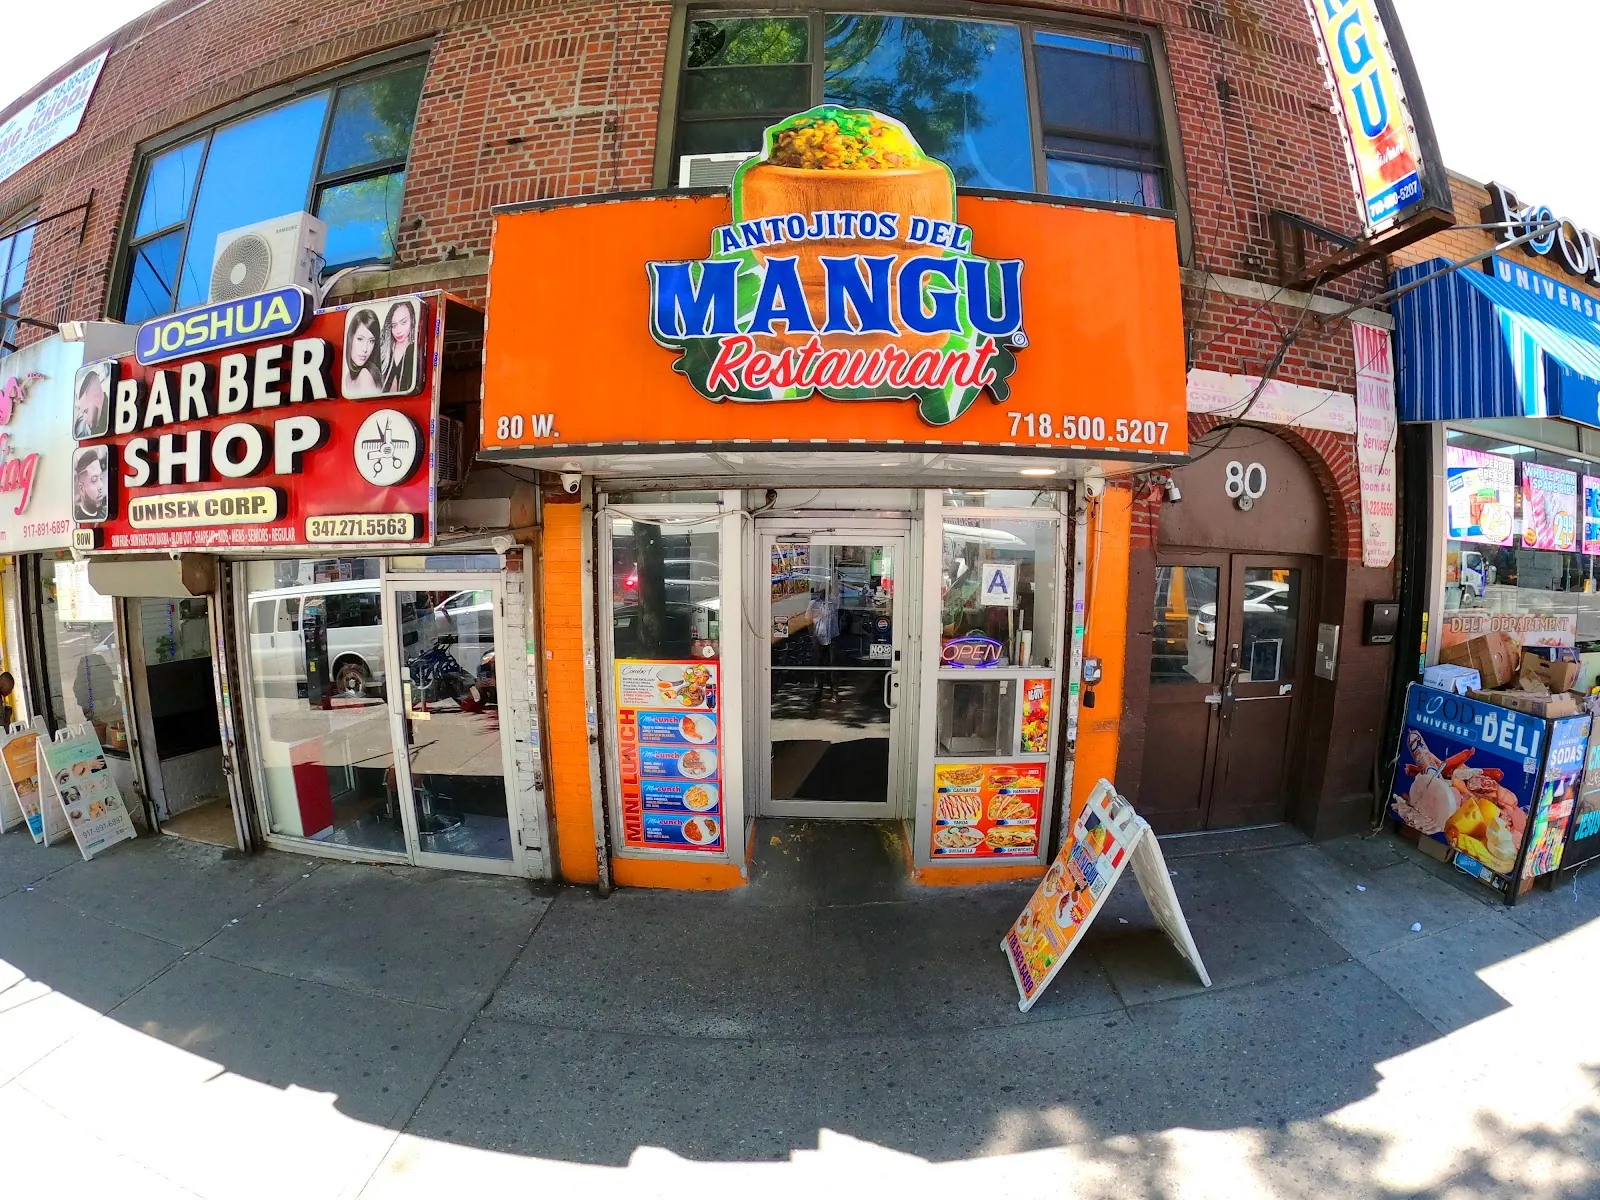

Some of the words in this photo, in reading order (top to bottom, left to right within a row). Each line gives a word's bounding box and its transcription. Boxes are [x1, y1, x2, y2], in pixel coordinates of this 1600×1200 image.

[24, 79, 92, 138] SCHOOL
[721, 212, 898, 253] ANTOJITOS
[909, 217, 970, 252] DEL
[651, 255, 1023, 337] MANGU
[143, 295, 292, 357] JOSHUA
[1353, 322, 1391, 375] VMR
[707, 335, 998, 392] Restaurant
[114, 337, 329, 436] BARBER
[1357, 382, 1374, 408] TAX
[496, 414, 523, 440] 80
[531, 413, 560, 438] W.
[1007, 411, 1169, 445] 718.500.5207
[124, 414, 321, 489] SHOP
[1224, 460, 1267, 499] 80
[1360, 462, 1373, 475] 2nd
[1524, 464, 1553, 481] WHOLE
[1555, 470, 1575, 485] PORK
[132, 499, 200, 523] UNISEX
[204, 495, 268, 517] CORP.
[23, 519, 70, 539] 917-891-6897
[75, 532, 91, 546] 80W
[247, 528, 269, 541] SENIORS
[271, 527, 296, 542] REGULAR
[311, 517, 407, 538] 347.271.5563
[986, 569, 1008, 595] A
[1451, 617, 1483, 633] DELI
[1491, 616, 1569, 633] DEPARTMENT
[871, 645, 883, 654] NO
[942, 644, 1003, 661] OPEN
[1417, 690, 1476, 725] FOOD
[1416, 713, 1470, 737] UNIVERSE
[1481, 715, 1540, 758] DELI
[619, 709, 639, 786] LUNCH
[1550, 743, 1583, 768] SODAS
[82, 814, 123, 839] 917-891-6897
[623, 792, 642, 842] MINI
